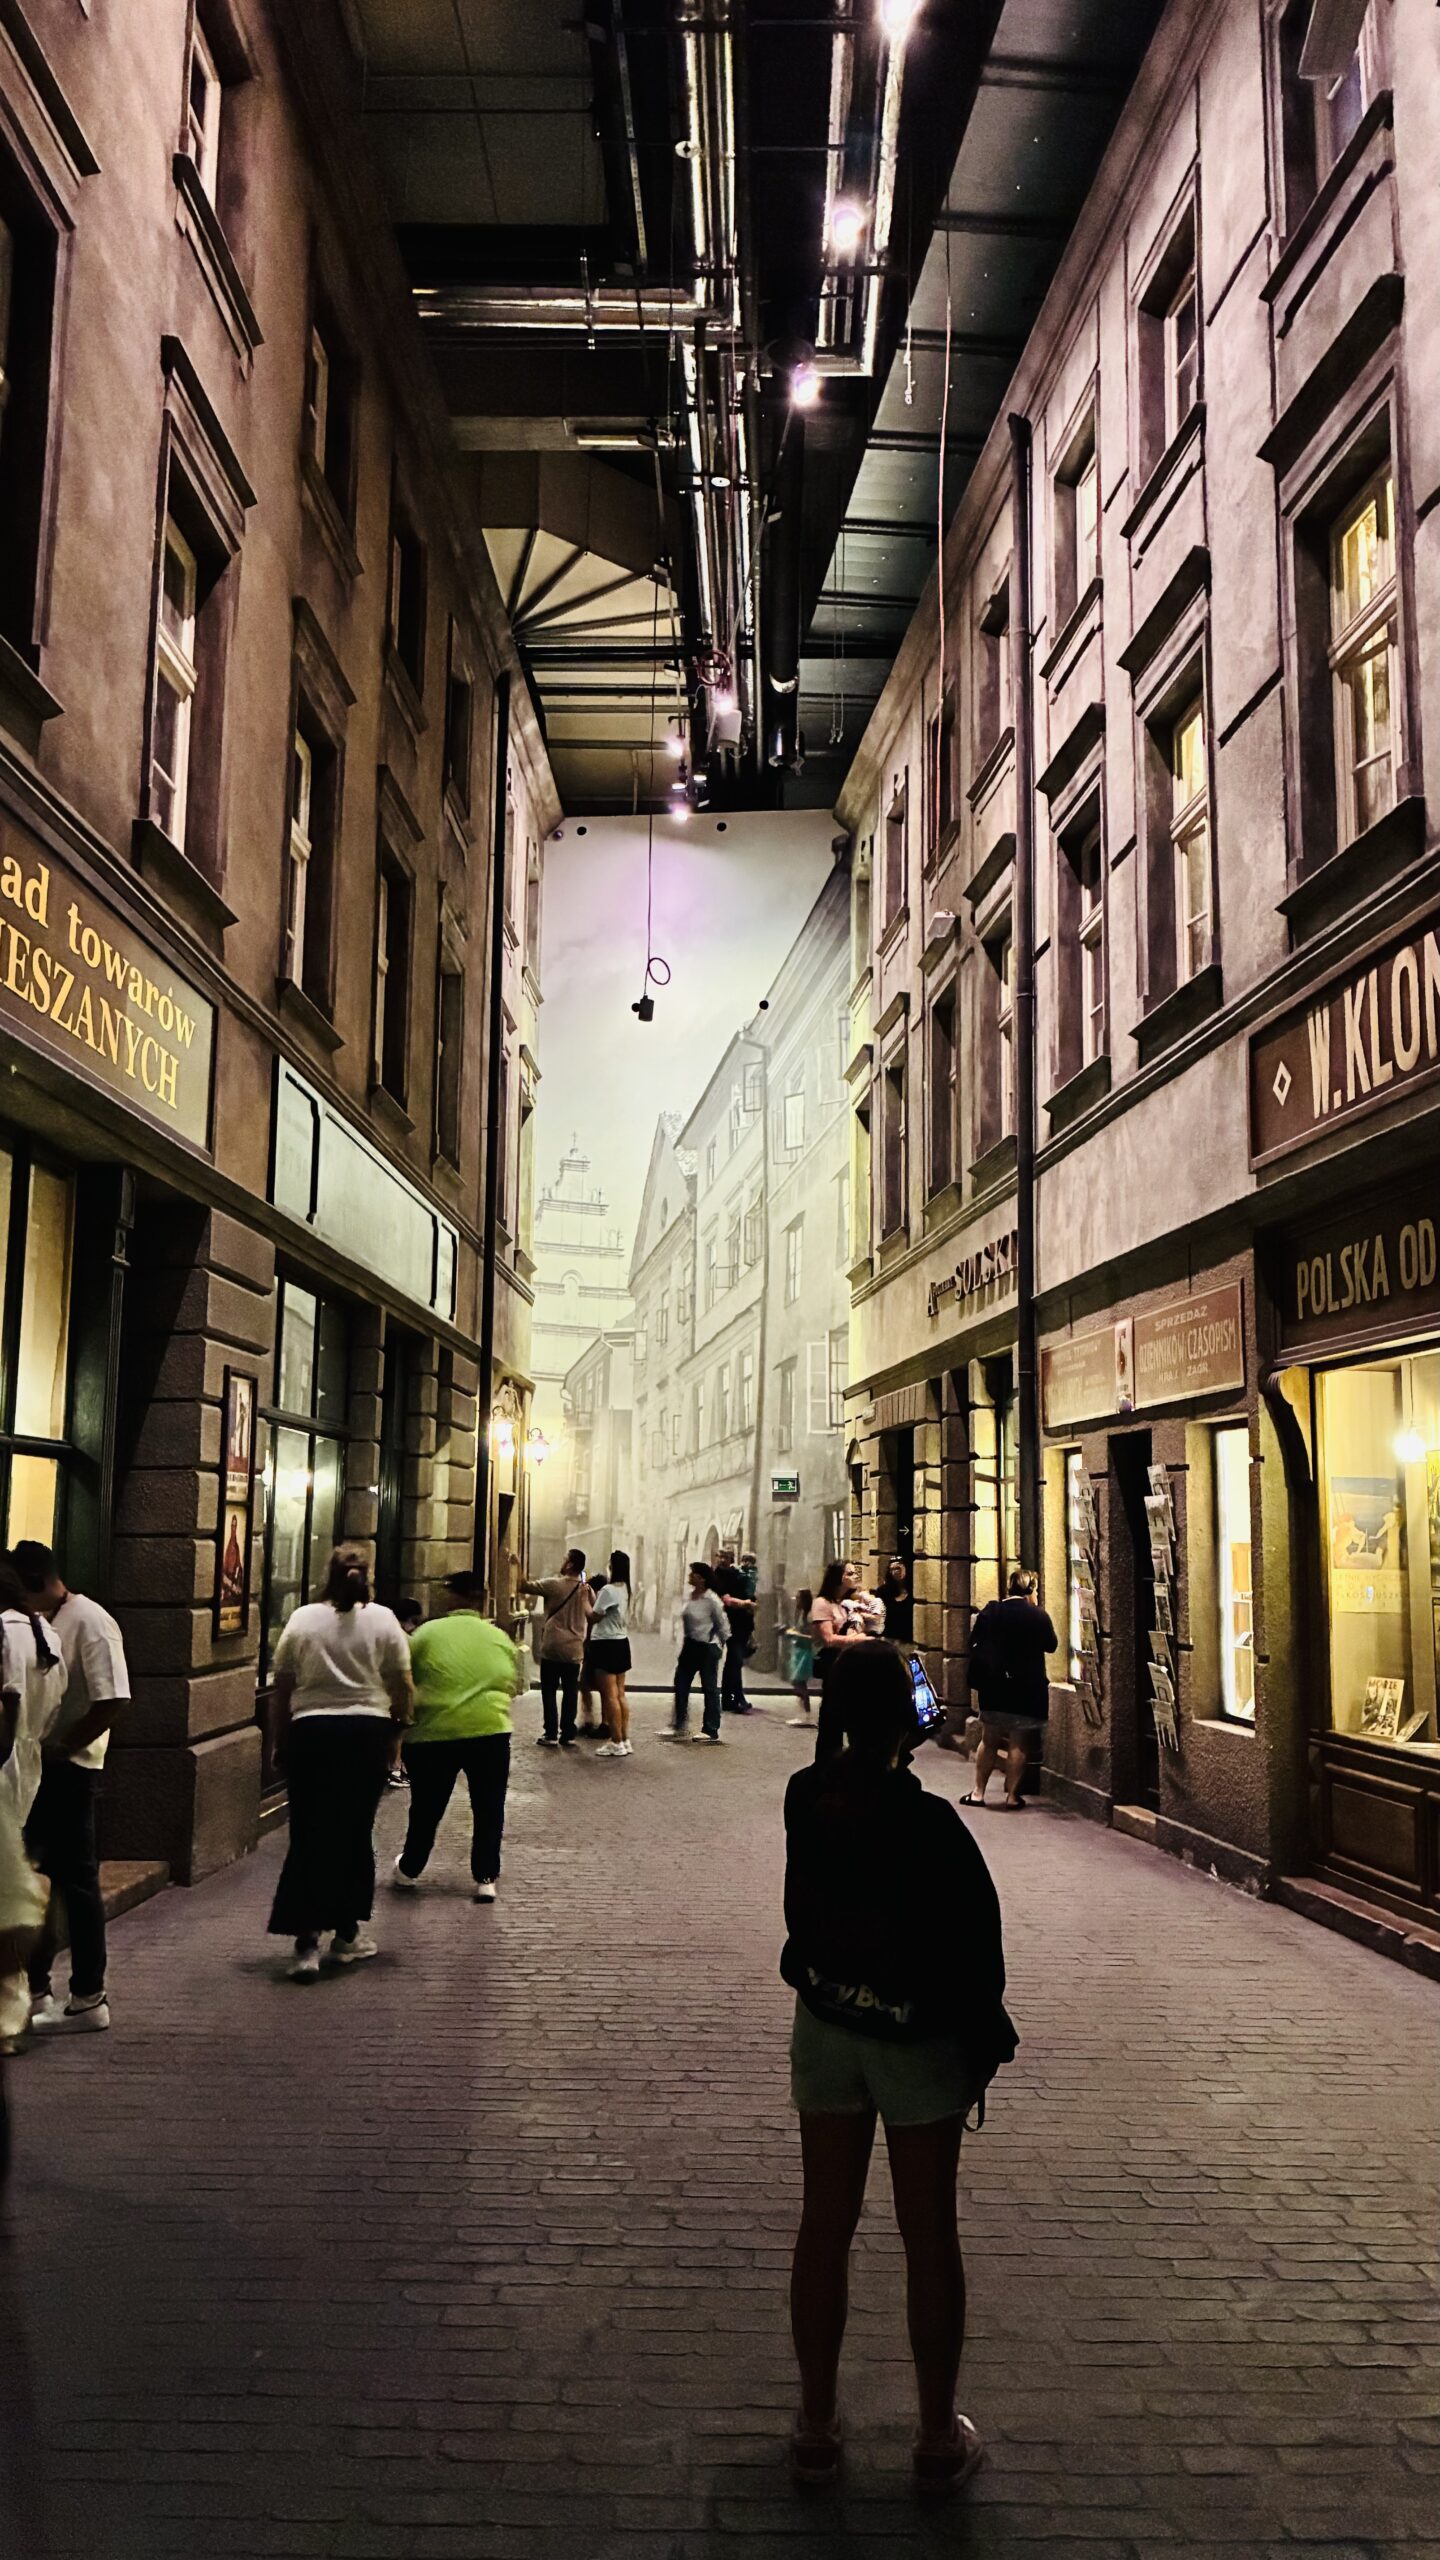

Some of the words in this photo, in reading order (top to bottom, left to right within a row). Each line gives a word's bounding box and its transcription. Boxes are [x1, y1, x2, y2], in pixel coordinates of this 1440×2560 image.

[0, 916, 179, 1110] ESZANYCH
[1, 856, 49, 928] ad
[67, 902, 197, 1049] towarów
[1187, 1314, 1236, 1361] CZASOPISM
[1297, 1234, 1390, 1320] POLSKA
[1399, 1218, 1436, 1290] OD
